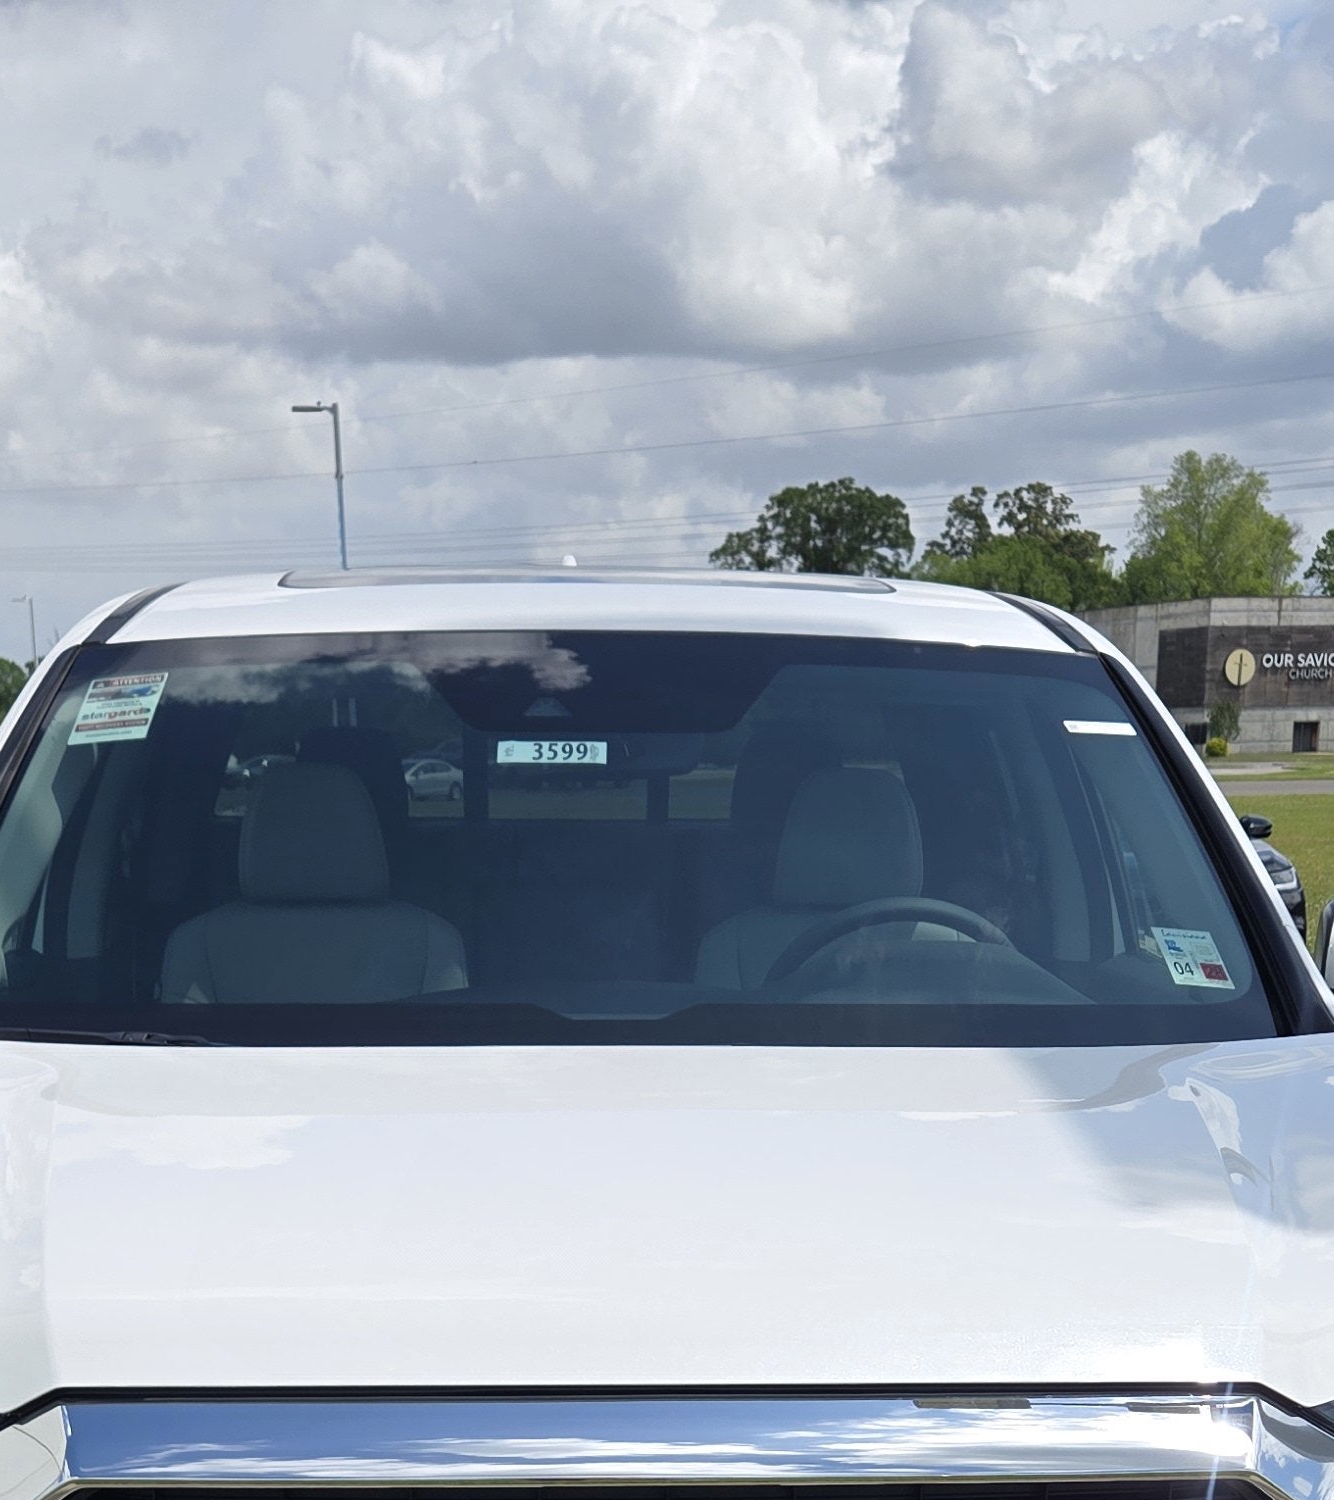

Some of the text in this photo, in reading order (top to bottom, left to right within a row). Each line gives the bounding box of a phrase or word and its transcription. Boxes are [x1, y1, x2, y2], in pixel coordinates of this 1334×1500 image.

[1262, 653, 1294, 668] OUR
[112, 675, 162, 686] ATTENTION
[1289, 668, 1333, 680] CHURCH
[532, 742, 588, 761] 3599
[1173, 961, 1194, 976] 04
